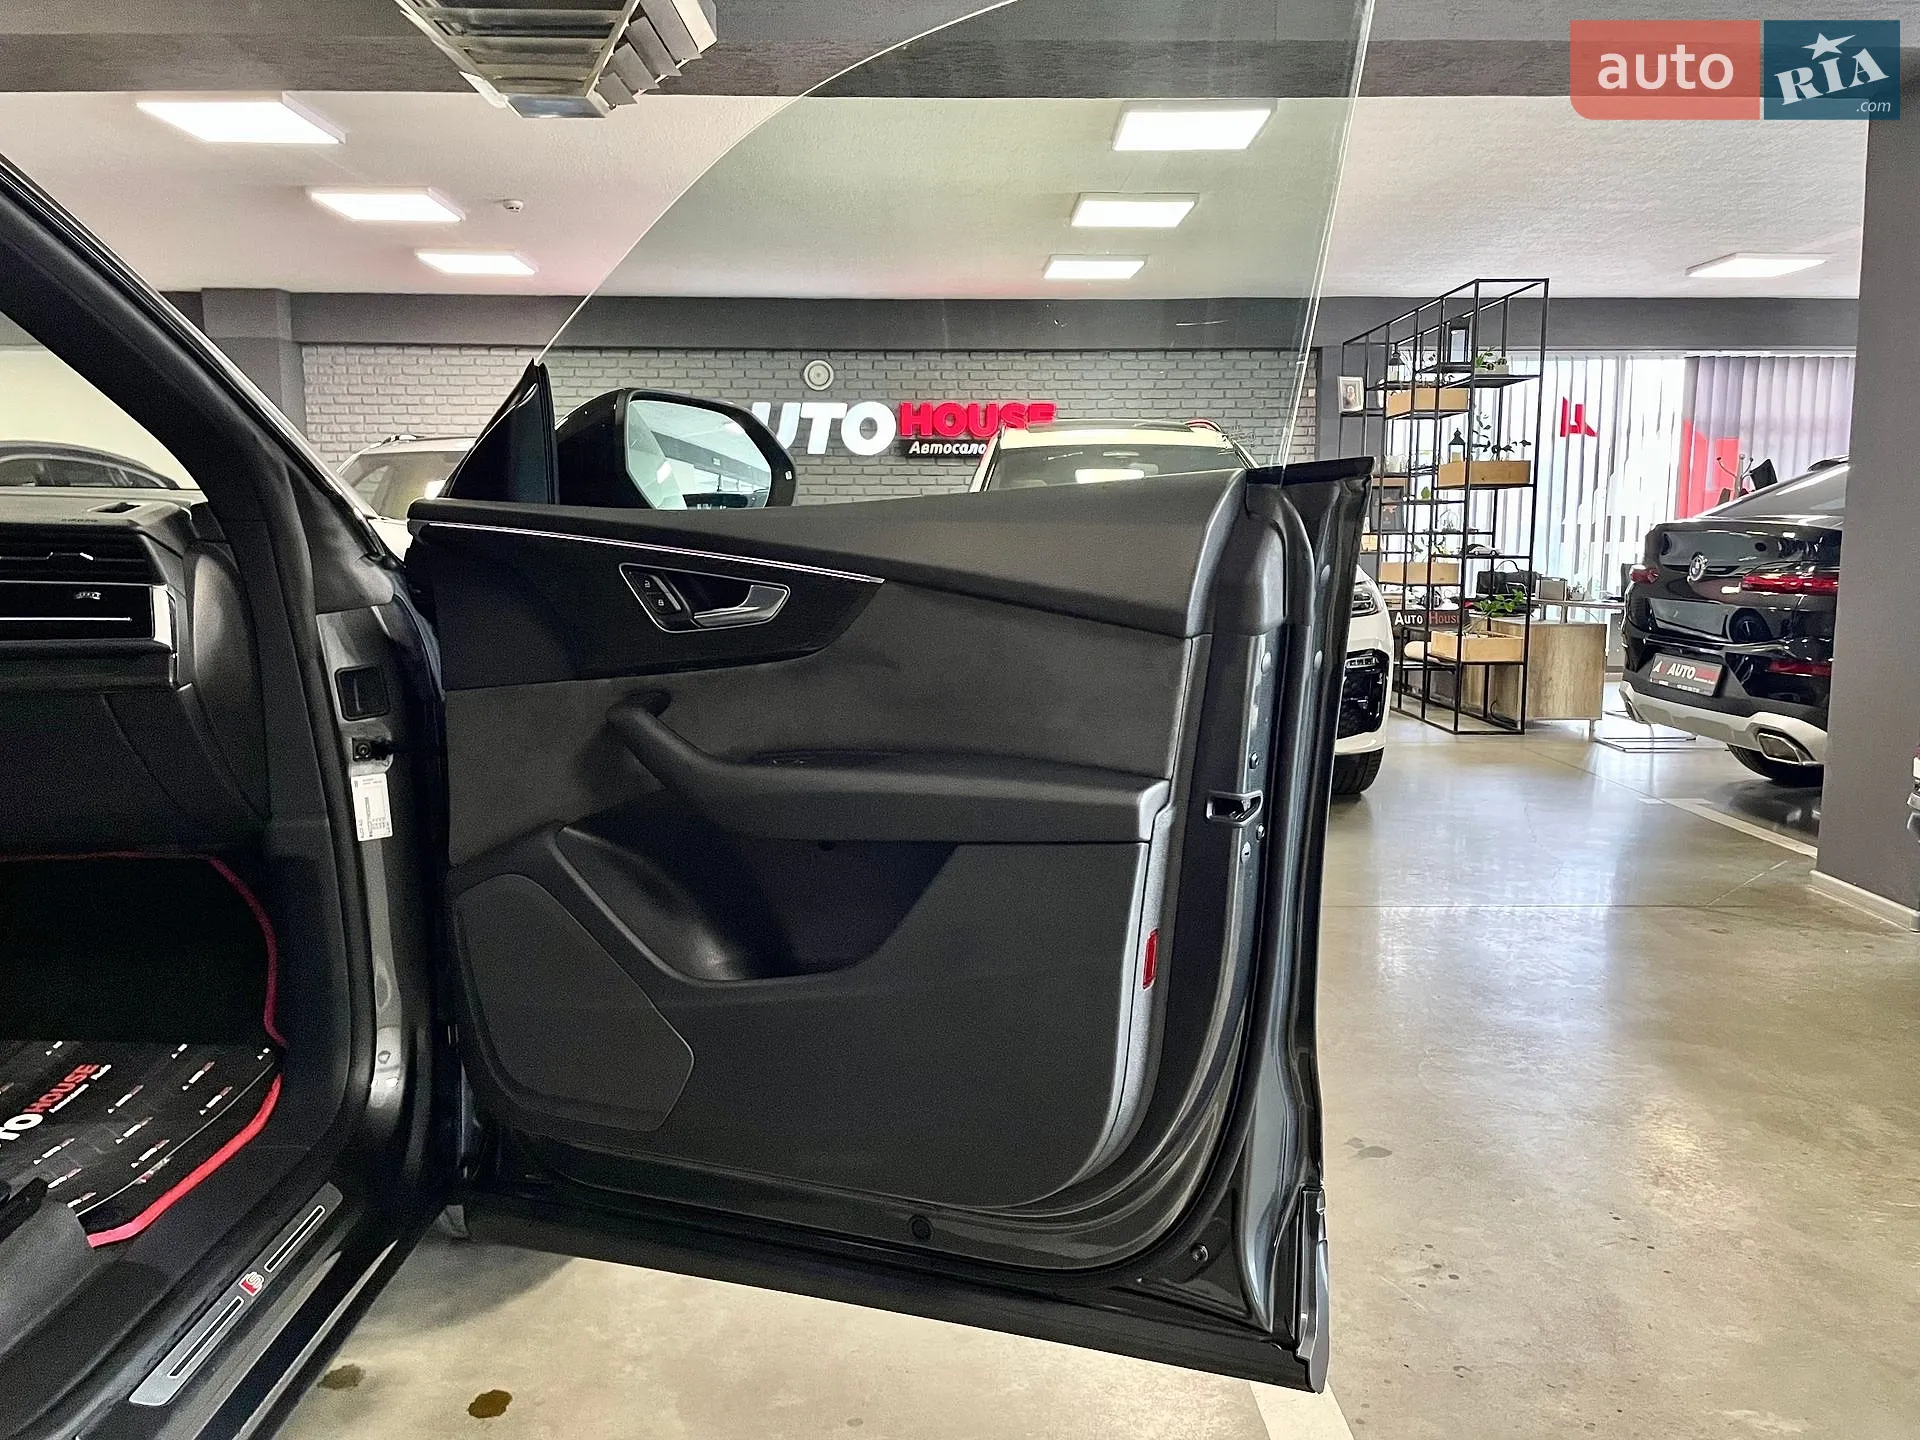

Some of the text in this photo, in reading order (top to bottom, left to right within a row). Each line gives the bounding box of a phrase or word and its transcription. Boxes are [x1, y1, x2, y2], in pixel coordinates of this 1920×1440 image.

[752, 401, 896, 456] UTO
[909, 440, 986, 455] Автосало
[1429, 611, 1460, 625] HOUS
[1667, 662, 1697, 680] AUTO
[22, 1063, 100, 1113] HOUSE
